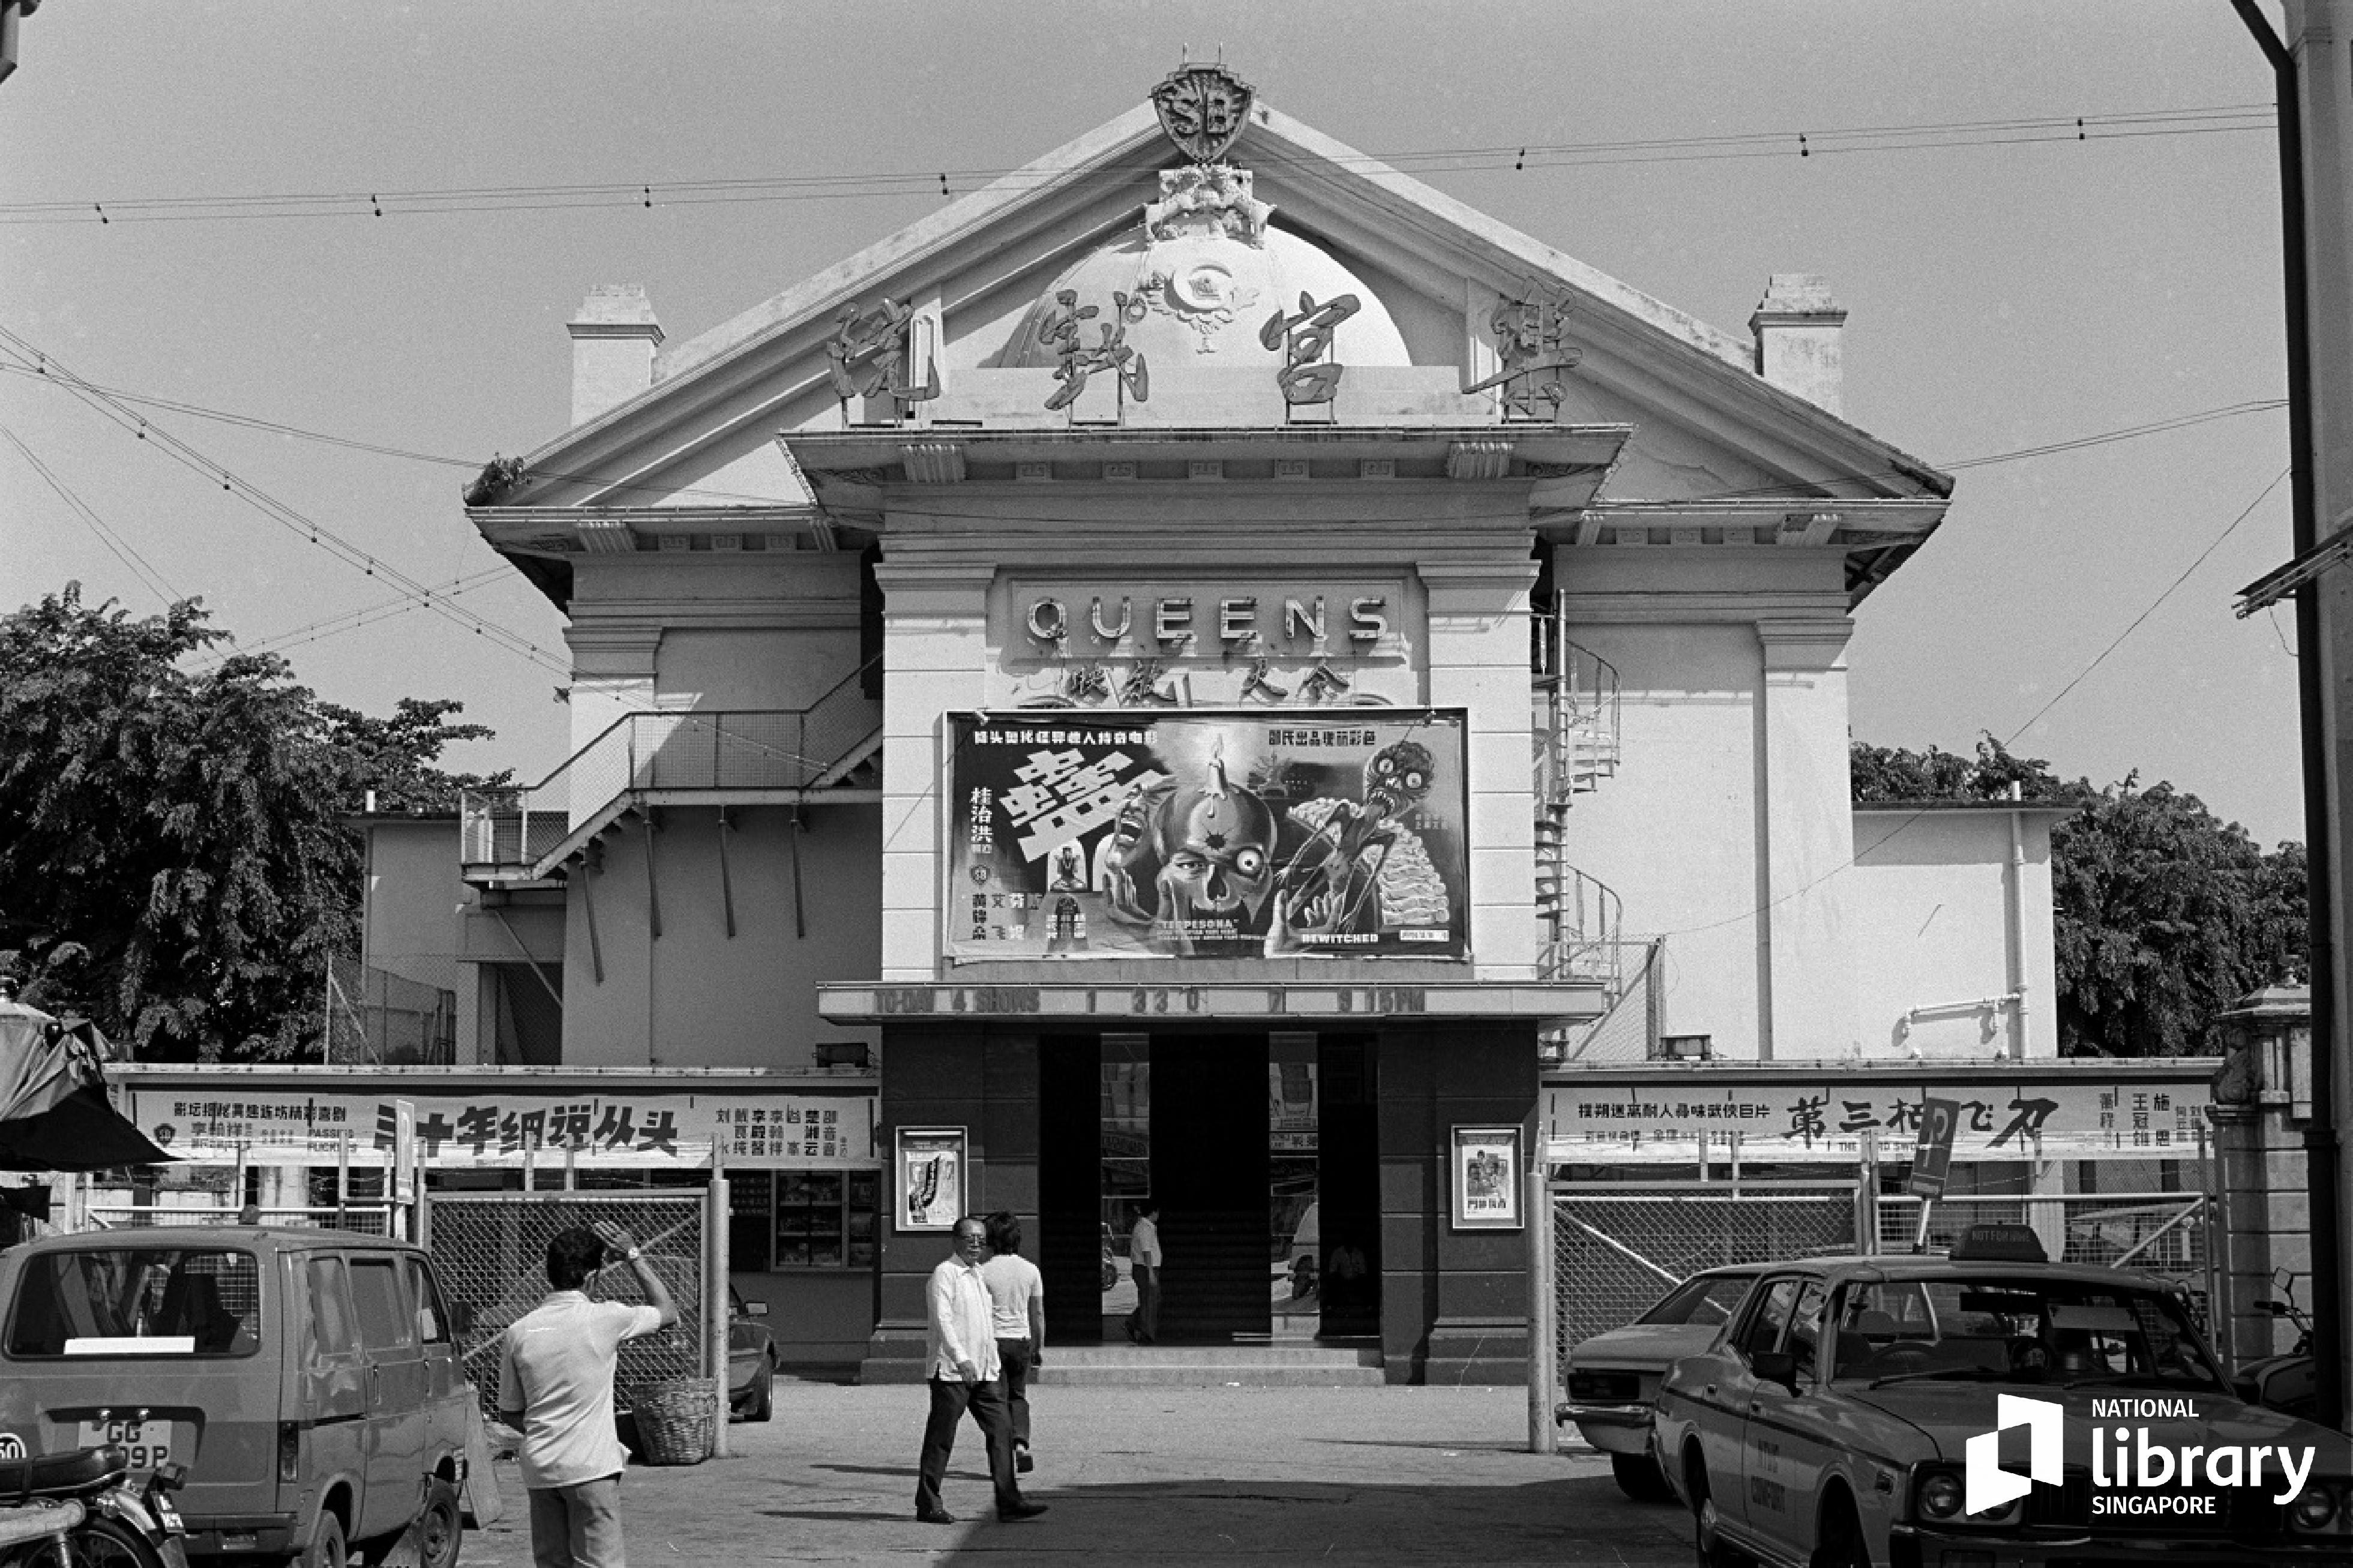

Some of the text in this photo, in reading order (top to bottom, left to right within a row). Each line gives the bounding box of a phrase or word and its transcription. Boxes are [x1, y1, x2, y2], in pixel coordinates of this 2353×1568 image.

[1161, 88, 1230, 138] SB
[1027, 596, 1387, 640] QUEENS
[1302, 933, 1379, 944] BEWITCHED
[951, 988, 966, 1013] 4
[1971, 1230, 1990, 1241] NOT
[107, 1422, 142, 1443] GG
